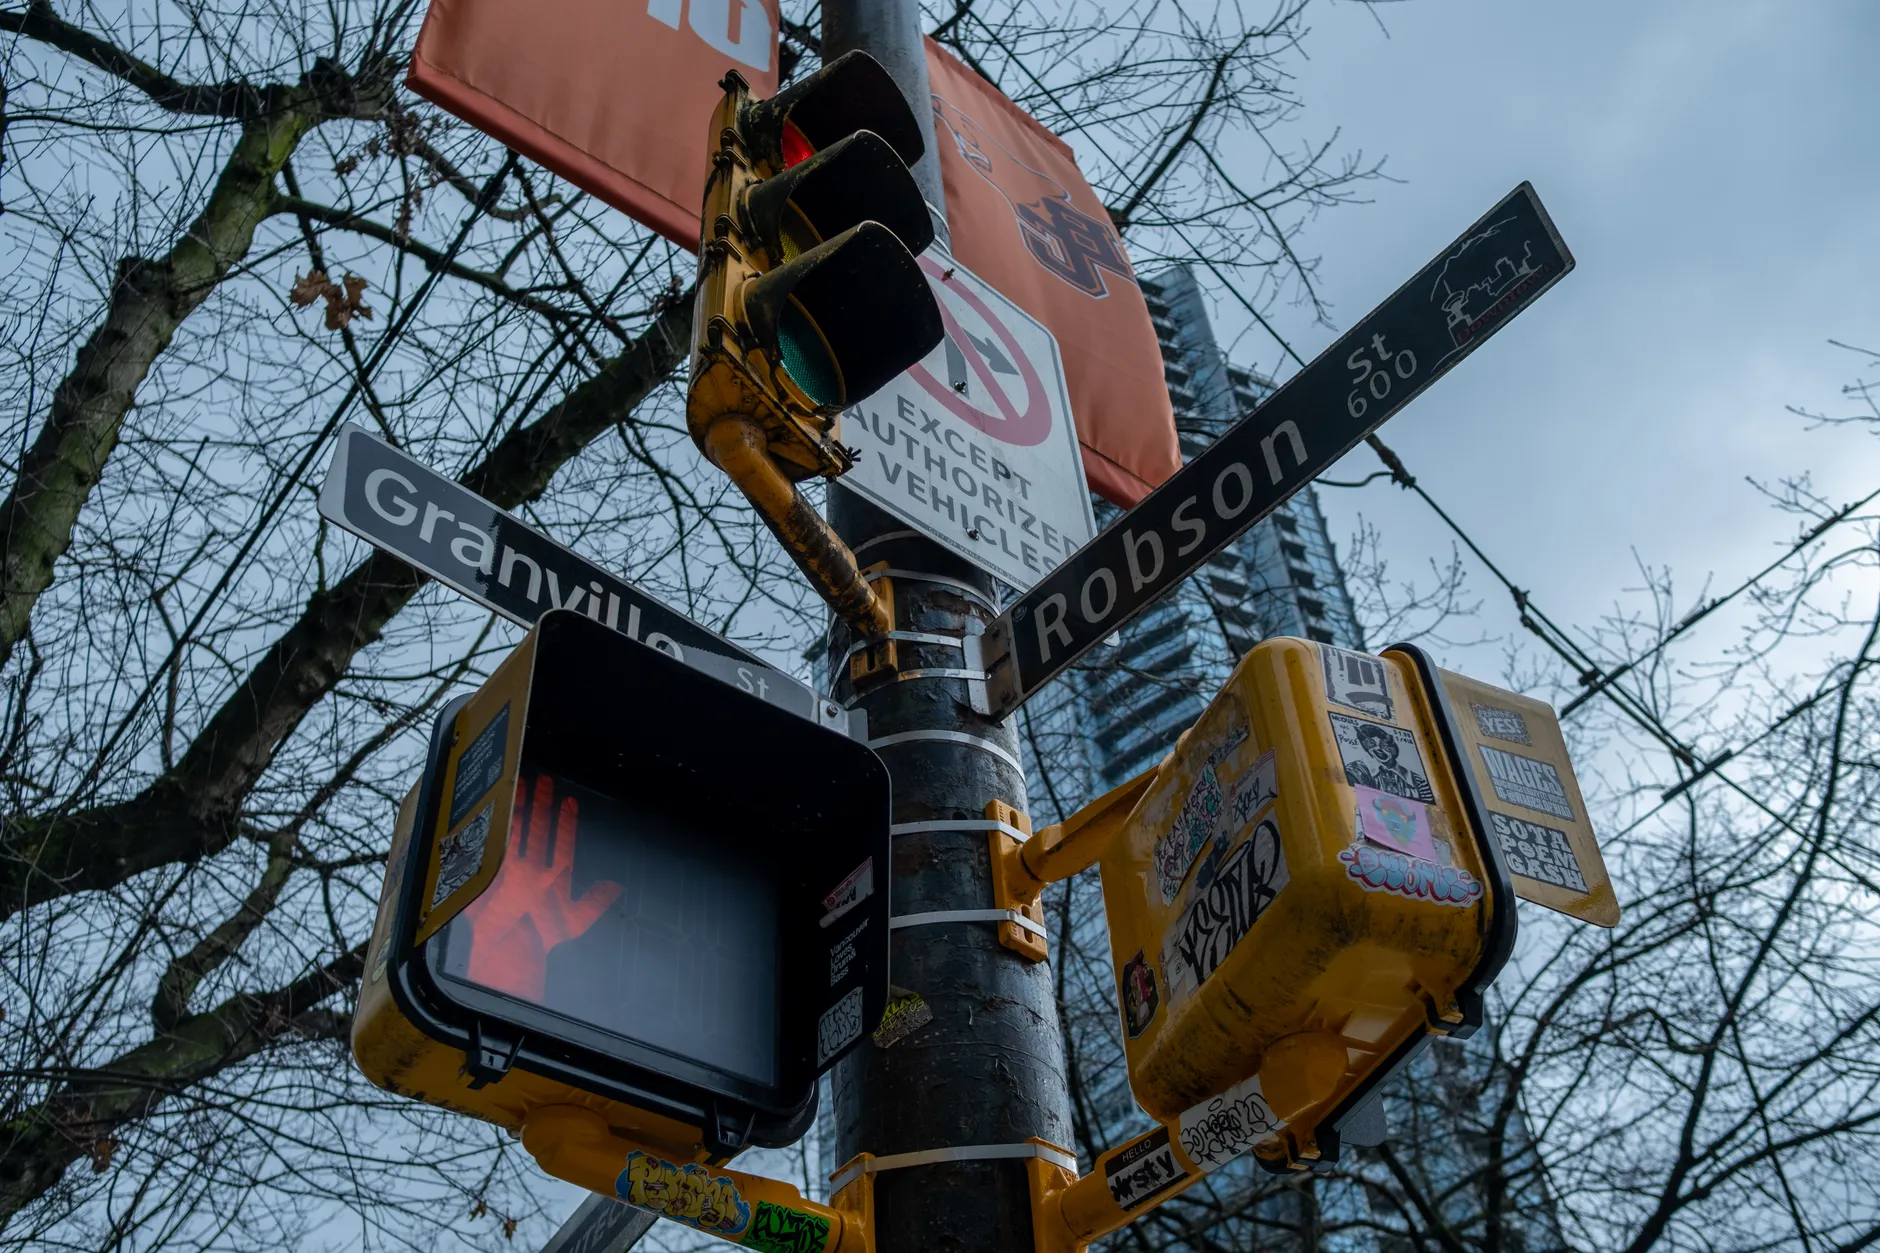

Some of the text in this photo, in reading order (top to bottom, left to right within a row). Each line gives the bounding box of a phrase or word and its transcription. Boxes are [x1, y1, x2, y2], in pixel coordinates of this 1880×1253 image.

[1347, 349, 1418, 419] 600
[897, 394, 1032, 501] EXCEPT
[1033, 332, 1394, 664] Robson St
[736, 667, 770, 700] St
[1482, 716, 1522, 735] YES!
[1478, 745, 1565, 797] WAGES
[1491, 813, 1572, 853] SOTA
[1505, 852, 1590, 894] GASH
[830, 917, 870, 957] Vancouver
[830, 943, 853, 968] Loves
[830, 966, 849, 988] Bass
[1121, 1138, 1152, 1164] HELLO
